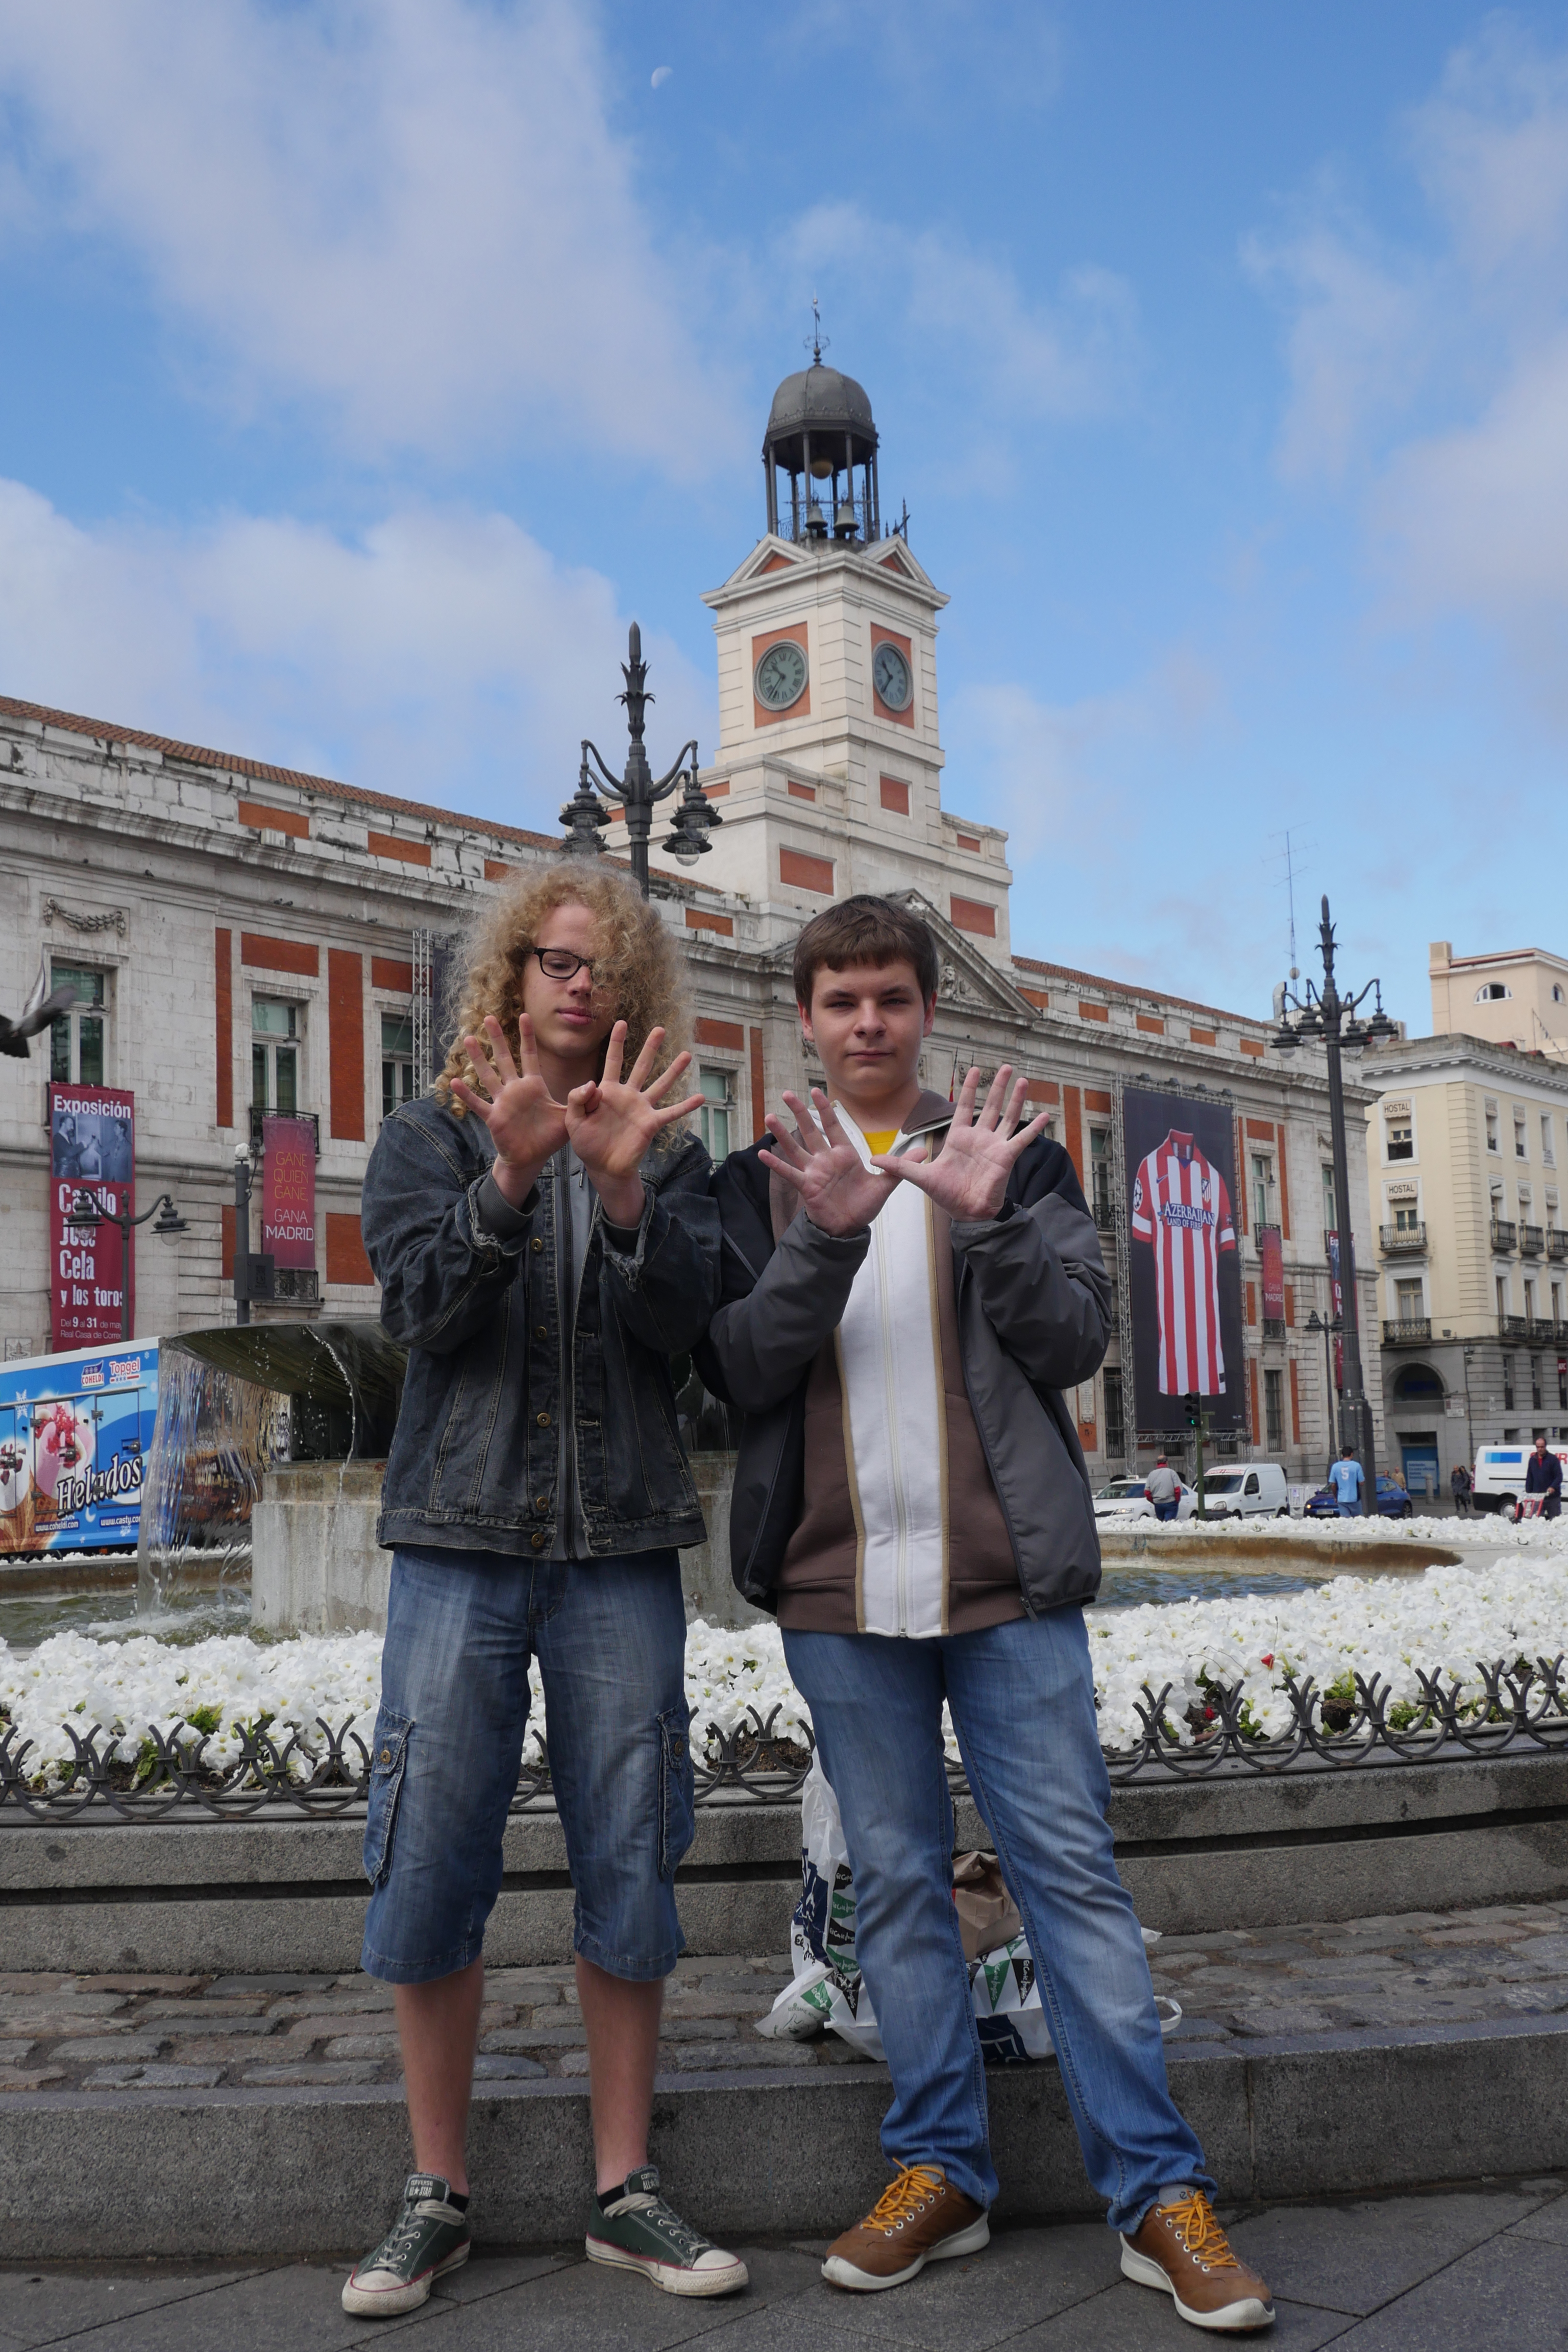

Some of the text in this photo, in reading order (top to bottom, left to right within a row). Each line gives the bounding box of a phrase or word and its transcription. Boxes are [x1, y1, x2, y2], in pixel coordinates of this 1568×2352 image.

[54, 1095, 131, 1119] Exposición
[1384, 1102, 1410, 1113] HOSTAL
[276, 1152, 307, 1167] GANE
[274, 1169, 308, 1184] QUIEN
[274, 1185, 308, 1202] GANE,
[1389, 1184, 1415, 1194] HOSTAL
[274, 1209, 308, 1224] GANA
[1164, 1200, 1215, 1228] AZERBAIJAN
[1167, 1217, 1202, 1231] LAND OF FIRE
[265, 1225, 314, 1241] MADRID
[60, 1250, 95, 1280] Cela
[61, 1290, 67, 1308] y
[72, 1285, 89, 1306] los
[1265, 1293, 1284, 1302] MADRID
[61, 1319, 71, 1327] Del
[72, 1316, 79, 1328] 9
[87, 1317, 97, 1328] 31
[110, 1322, 122, 1331] may
[103, 1331, 121, 1339] Corre
[109, 1358, 140, 1376] Topgel
[82, 1374, 104, 1385] COHELDI
[1341, 1466, 1350, 1480] 5
[57, 1454, 142, 1518] Helados
[35, 1521, 79, 1532] www.coheldi.com
